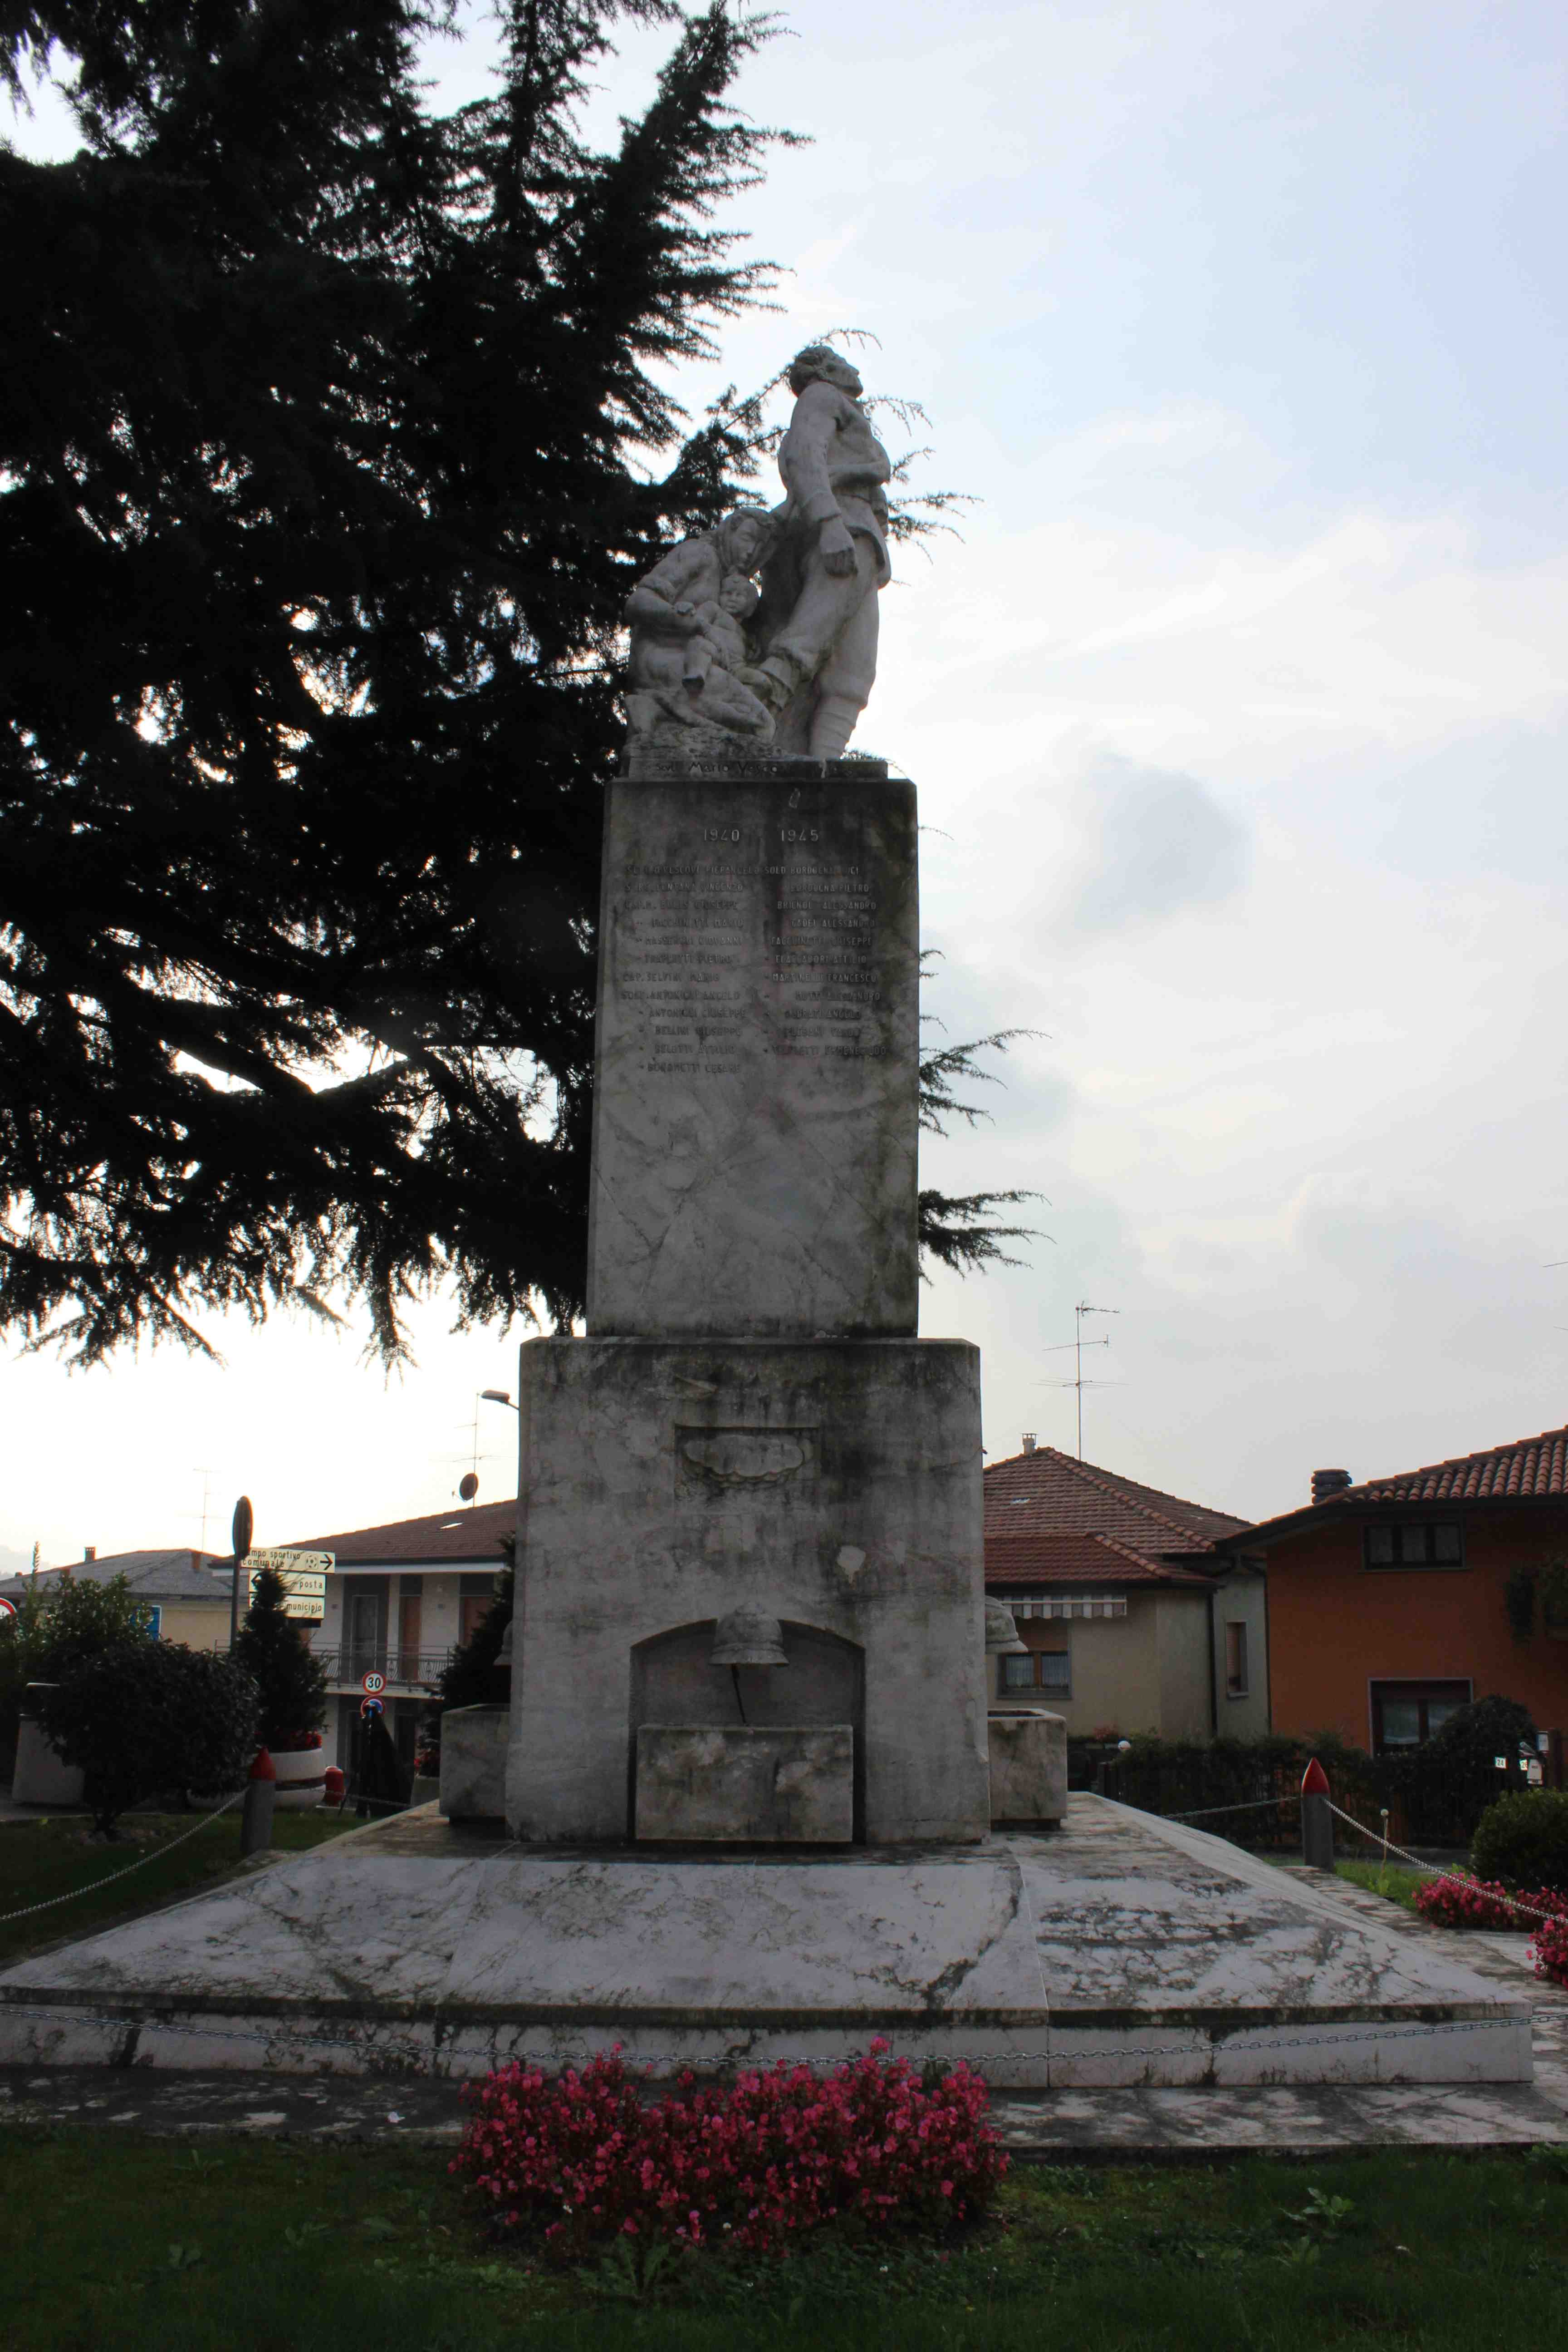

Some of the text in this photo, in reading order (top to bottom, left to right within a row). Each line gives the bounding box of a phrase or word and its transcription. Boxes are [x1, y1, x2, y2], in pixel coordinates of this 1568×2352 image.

[688, 762, 729, 772] Mario
[704, 828, 818, 842] 1940 1945
[822, 901, 877, 910] ALESSANDRO
[827, 973, 877, 983] FRANCESCO
[251, 1548, 301, 1560] mpo sportivo
[242, 1559, 284, 1568] comunale
[299, 1579, 323, 1590] posta
[286, 1602, 323, 1613] municipio
[368, 1676, 381, 1688] 30
